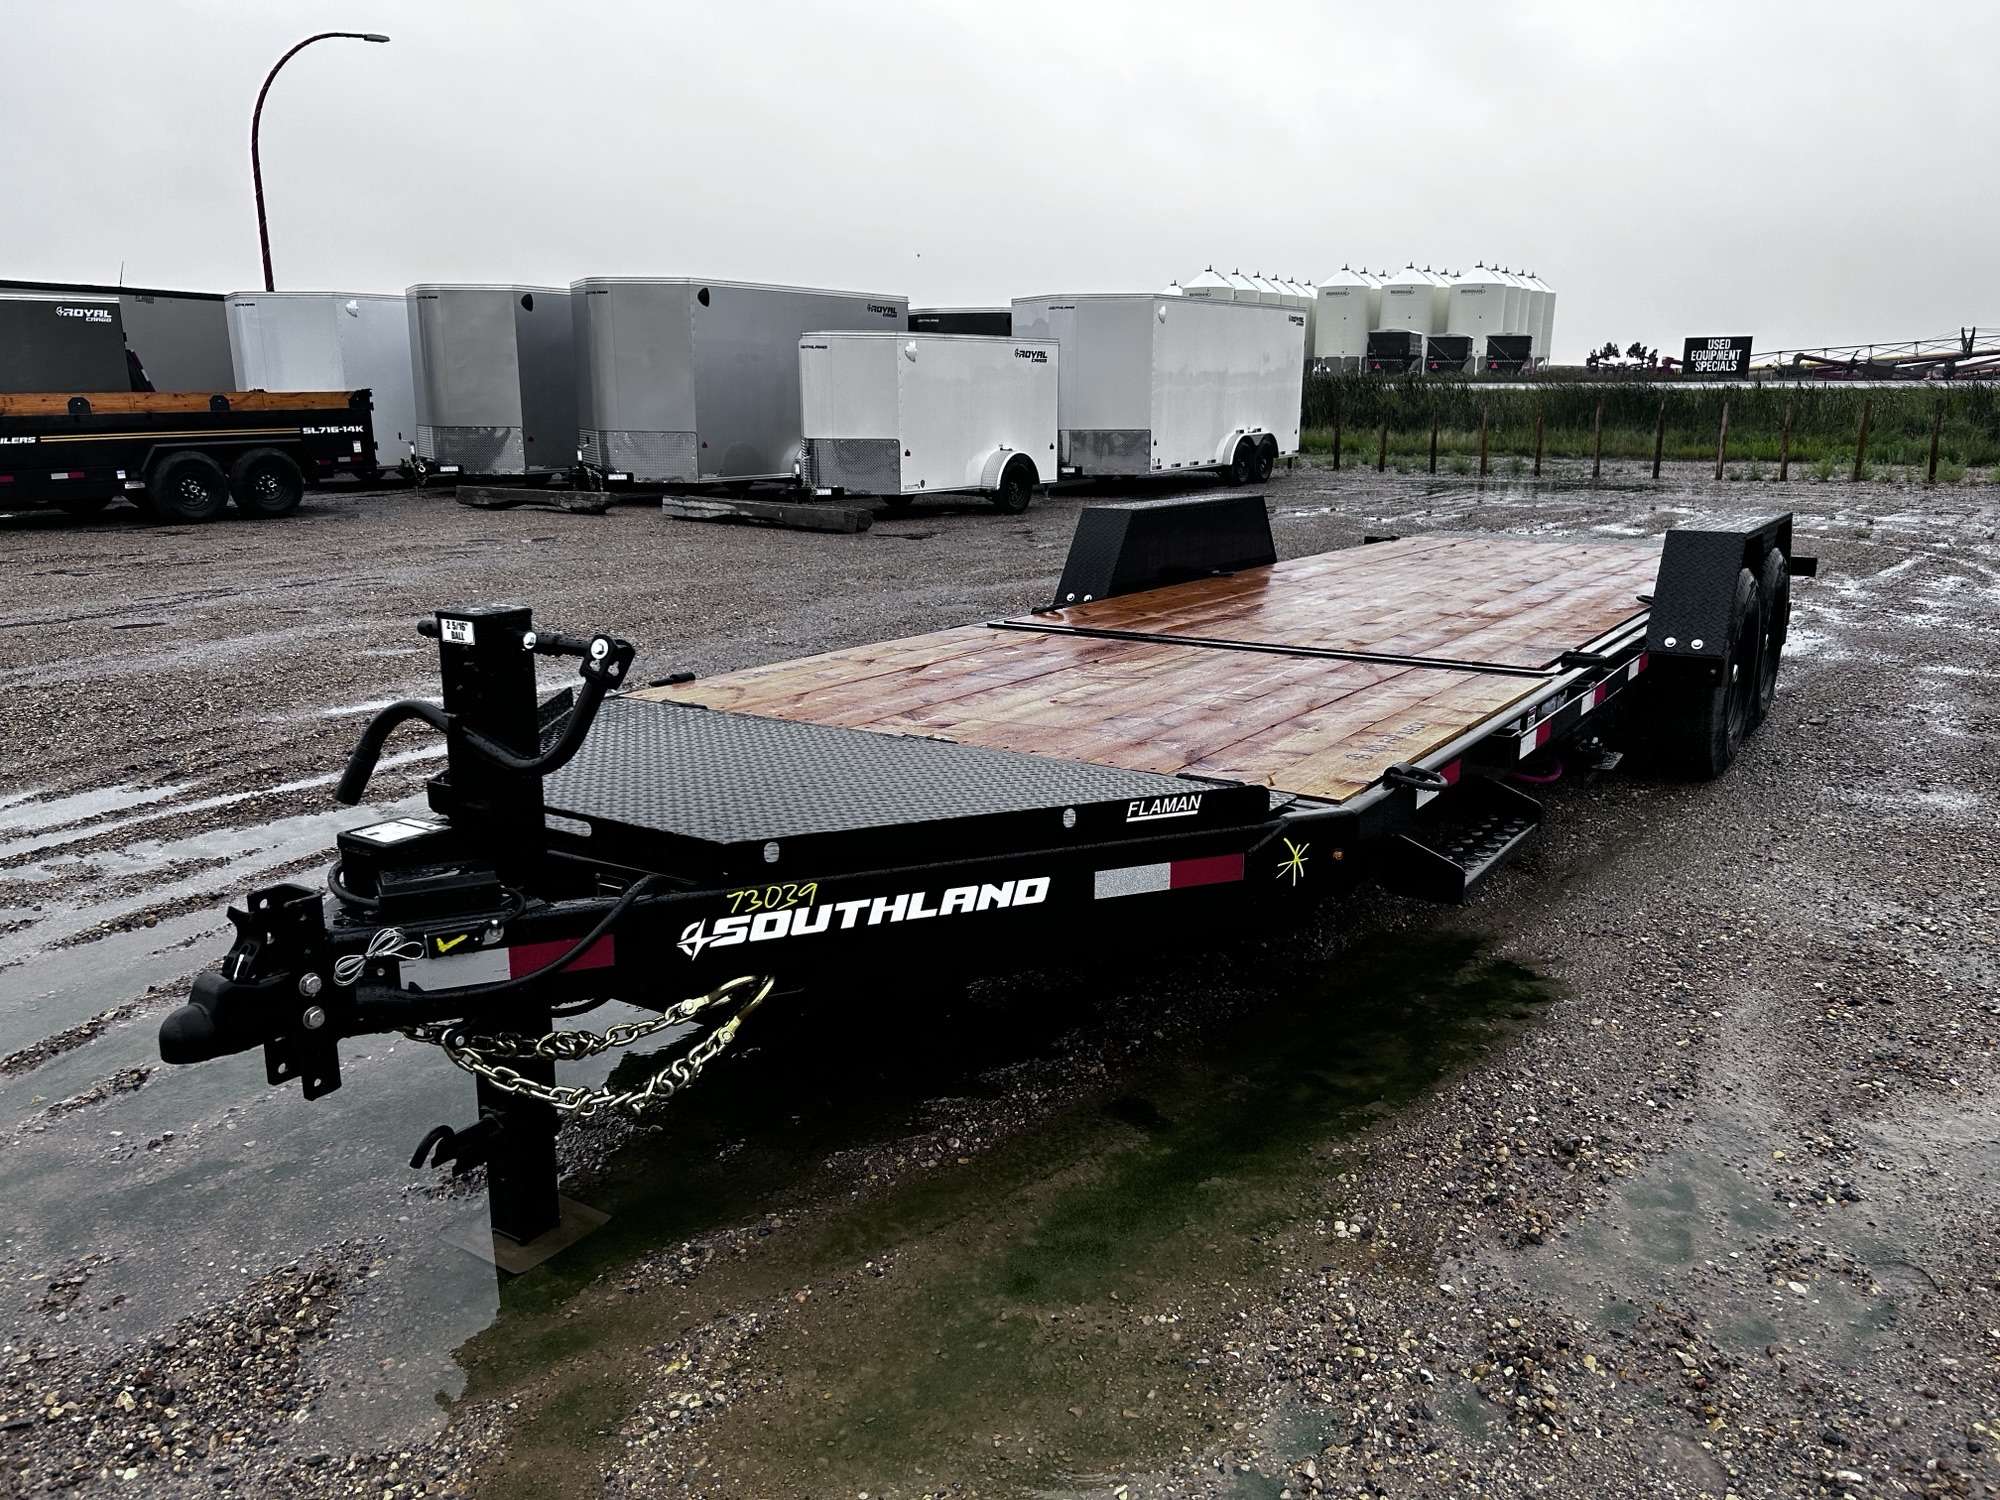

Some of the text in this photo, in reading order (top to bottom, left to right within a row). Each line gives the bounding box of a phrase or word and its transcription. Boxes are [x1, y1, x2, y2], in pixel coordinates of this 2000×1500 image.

[63, 308, 112, 318] ROYAL
[1707, 338, 1731, 350] USED
[1019, 350, 1048, 359] ROYAL
[1690, 349, 1743, 361] EQUIPMENT
[1695, 360, 1738, 372] SPECIALS
[302, 425, 364, 434] SL716-14K
[0, 436, 37, 444] ILERS
[446, 620, 451, 630] 2
[451, 631, 465, 641] BALL
[1127, 794, 1202, 817] FLAMAN
[726, 883, 818, 913] 73039
[709, 877, 1051, 948] SOUTHLAND
